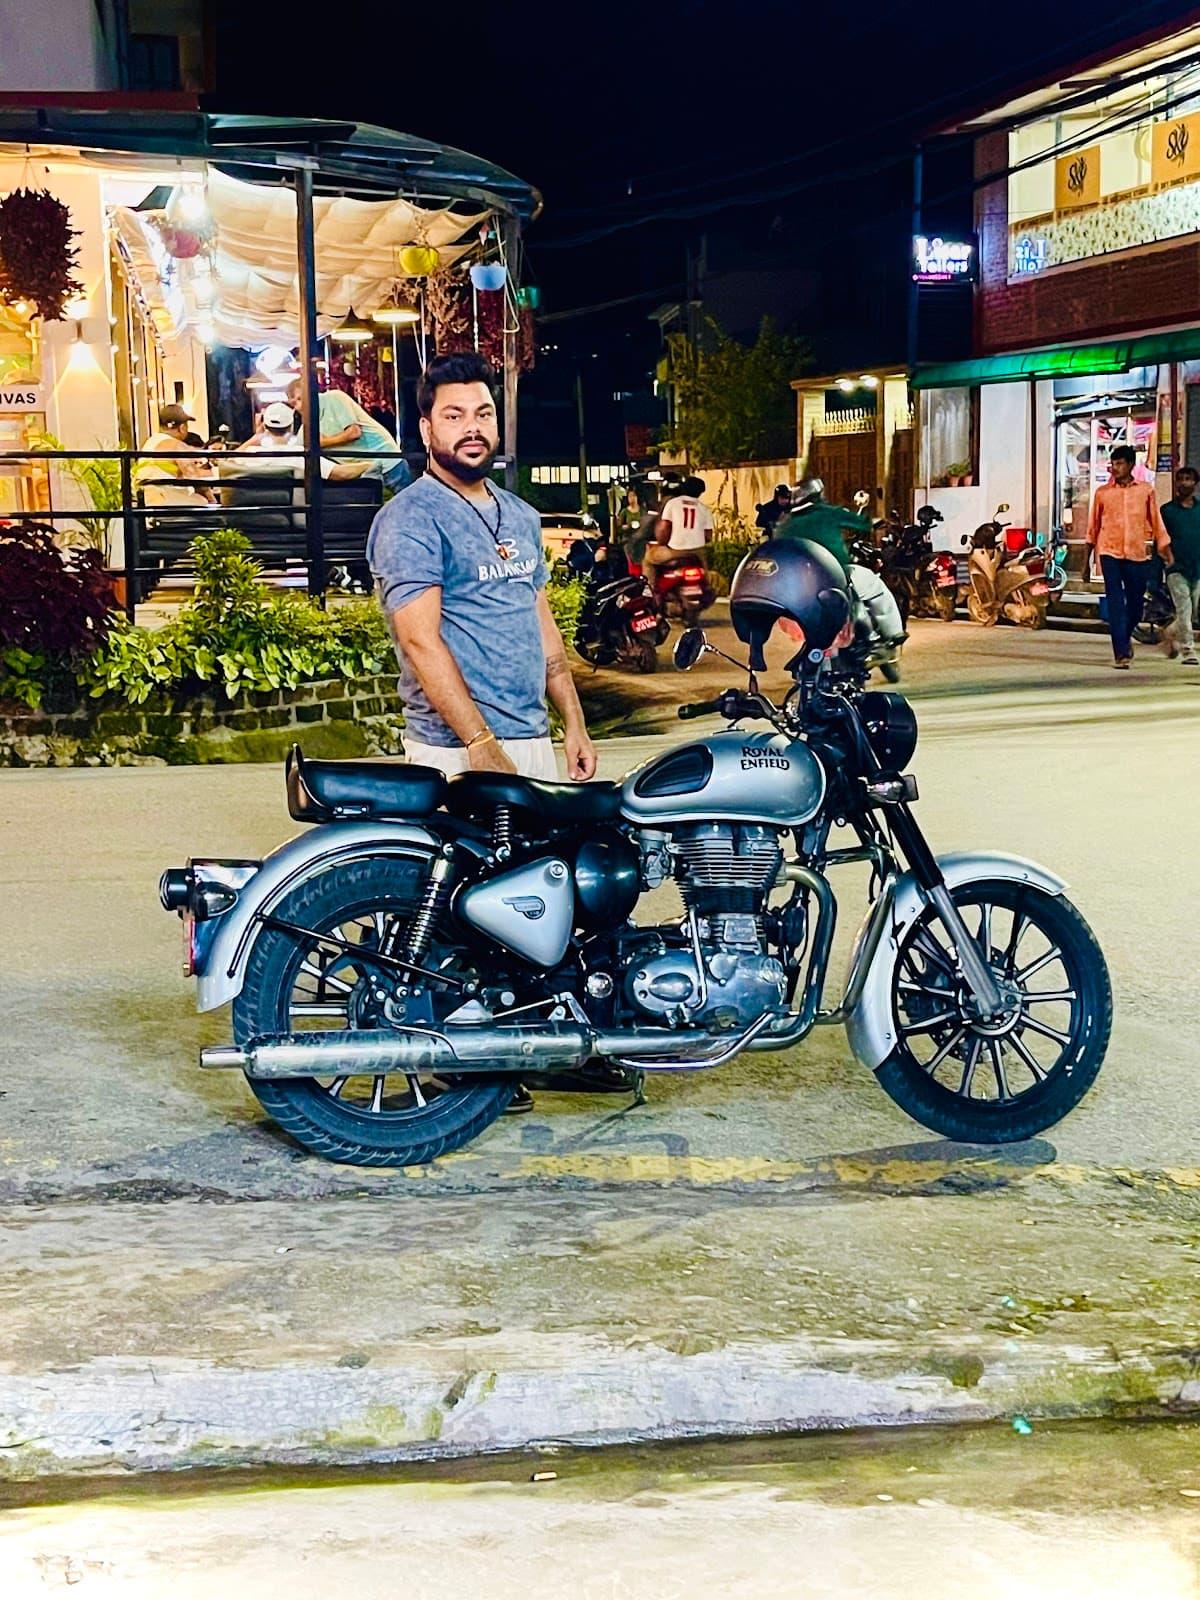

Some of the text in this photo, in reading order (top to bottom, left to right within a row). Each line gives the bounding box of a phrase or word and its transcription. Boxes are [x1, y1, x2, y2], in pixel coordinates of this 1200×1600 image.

[683, 507, 695, 529] 11
[742, 746, 785, 758] ROYAL
[740, 758, 790, 771] ENFIELD
